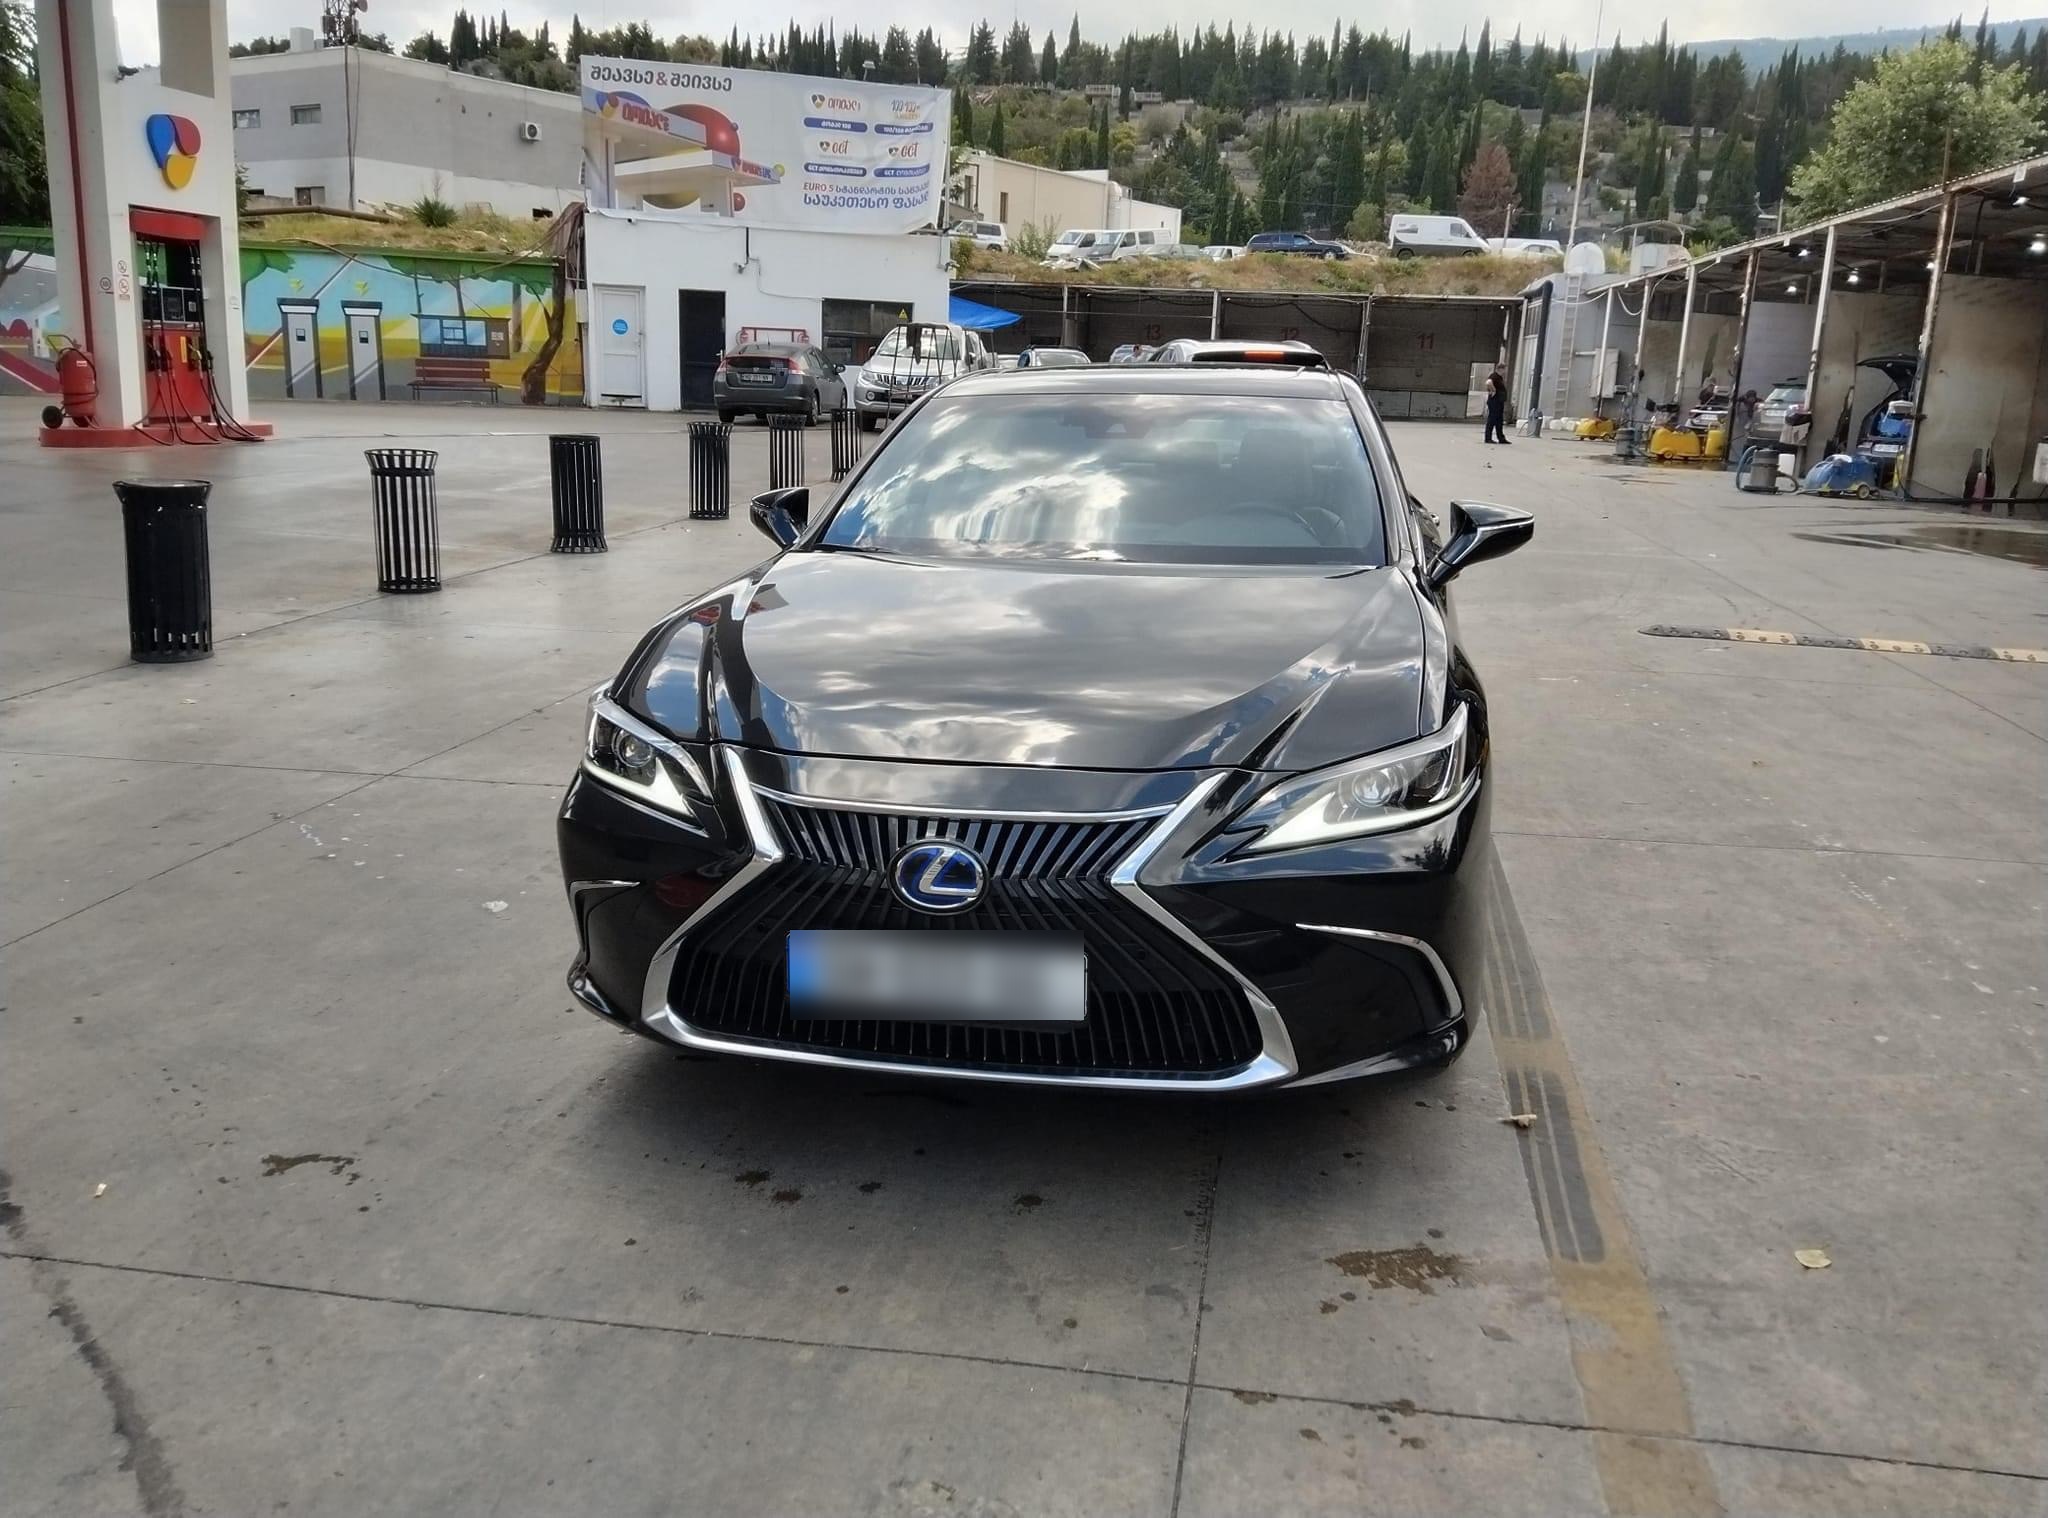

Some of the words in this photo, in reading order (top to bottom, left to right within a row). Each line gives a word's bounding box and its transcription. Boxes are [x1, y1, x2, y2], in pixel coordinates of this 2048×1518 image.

[590, 65, 654, 85] შეავსე
[656, 72, 668, 86] &
[670, 72, 732, 92] შეივსე
[804, 182, 827, 192] EURO
[829, 184, 834, 192] 5
[804, 193, 889, 208] საუკეთესო
[1147, 323, 1169, 340] 13
[1280, 327, 1300, 340] 12
[1416, 332, 1434, 350] 11
